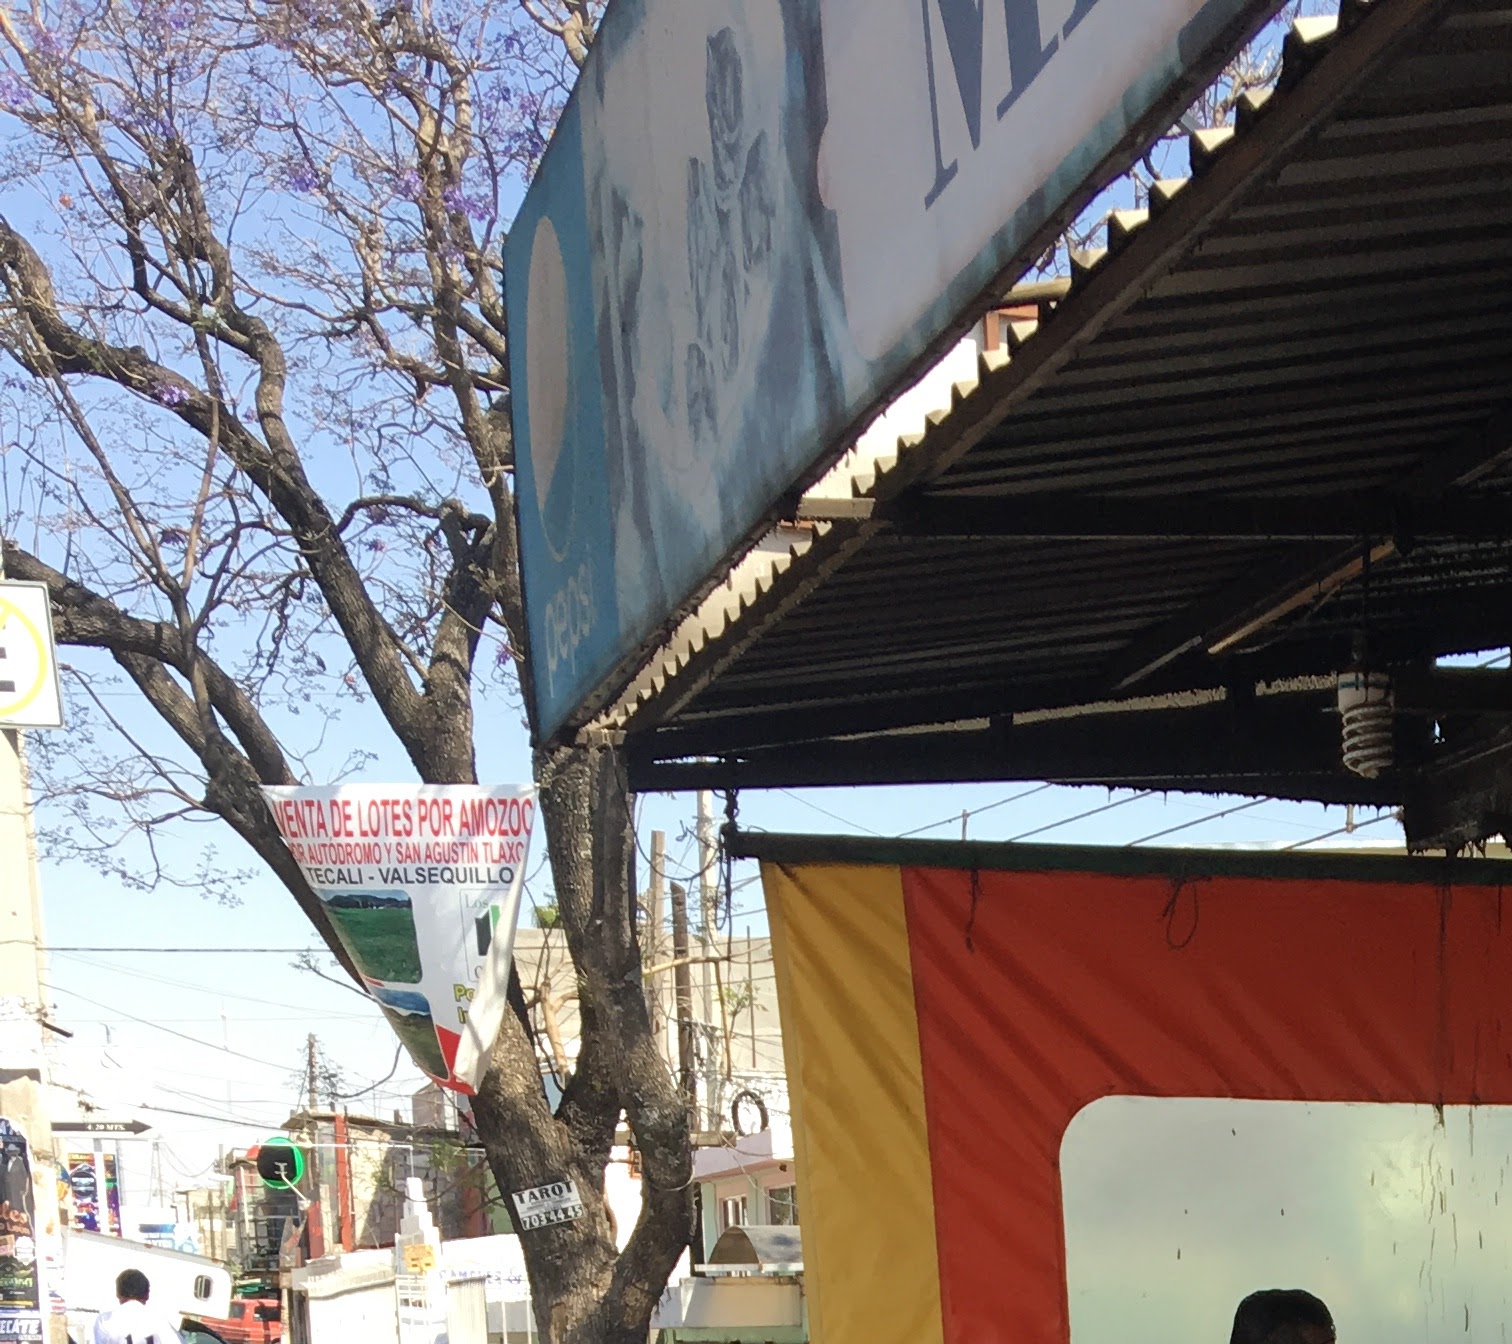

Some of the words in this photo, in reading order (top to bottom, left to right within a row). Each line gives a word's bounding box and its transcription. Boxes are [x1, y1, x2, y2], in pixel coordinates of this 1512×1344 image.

[273, 799, 329, 838] VENTA
[330, 799, 354, 838] DE
[359, 799, 413, 838] LOTES
[418, 798, 455, 837] POR
[459, 798, 533, 837] AMOZOC
[289, 842, 307, 864] OR
[384, 842, 392, 864] Y
[396, 842, 421, 864] SAN
[306, 867, 364, 885] TECALI
[378, 867, 515, 885] VALSEQUILLO
[515, 1180, 573, 1204] TAROT
[522, 1210, 547, 1229] 703
[567, 1204, 583, 1219] 45
[0, 1319, 40, 1334] ECATE
